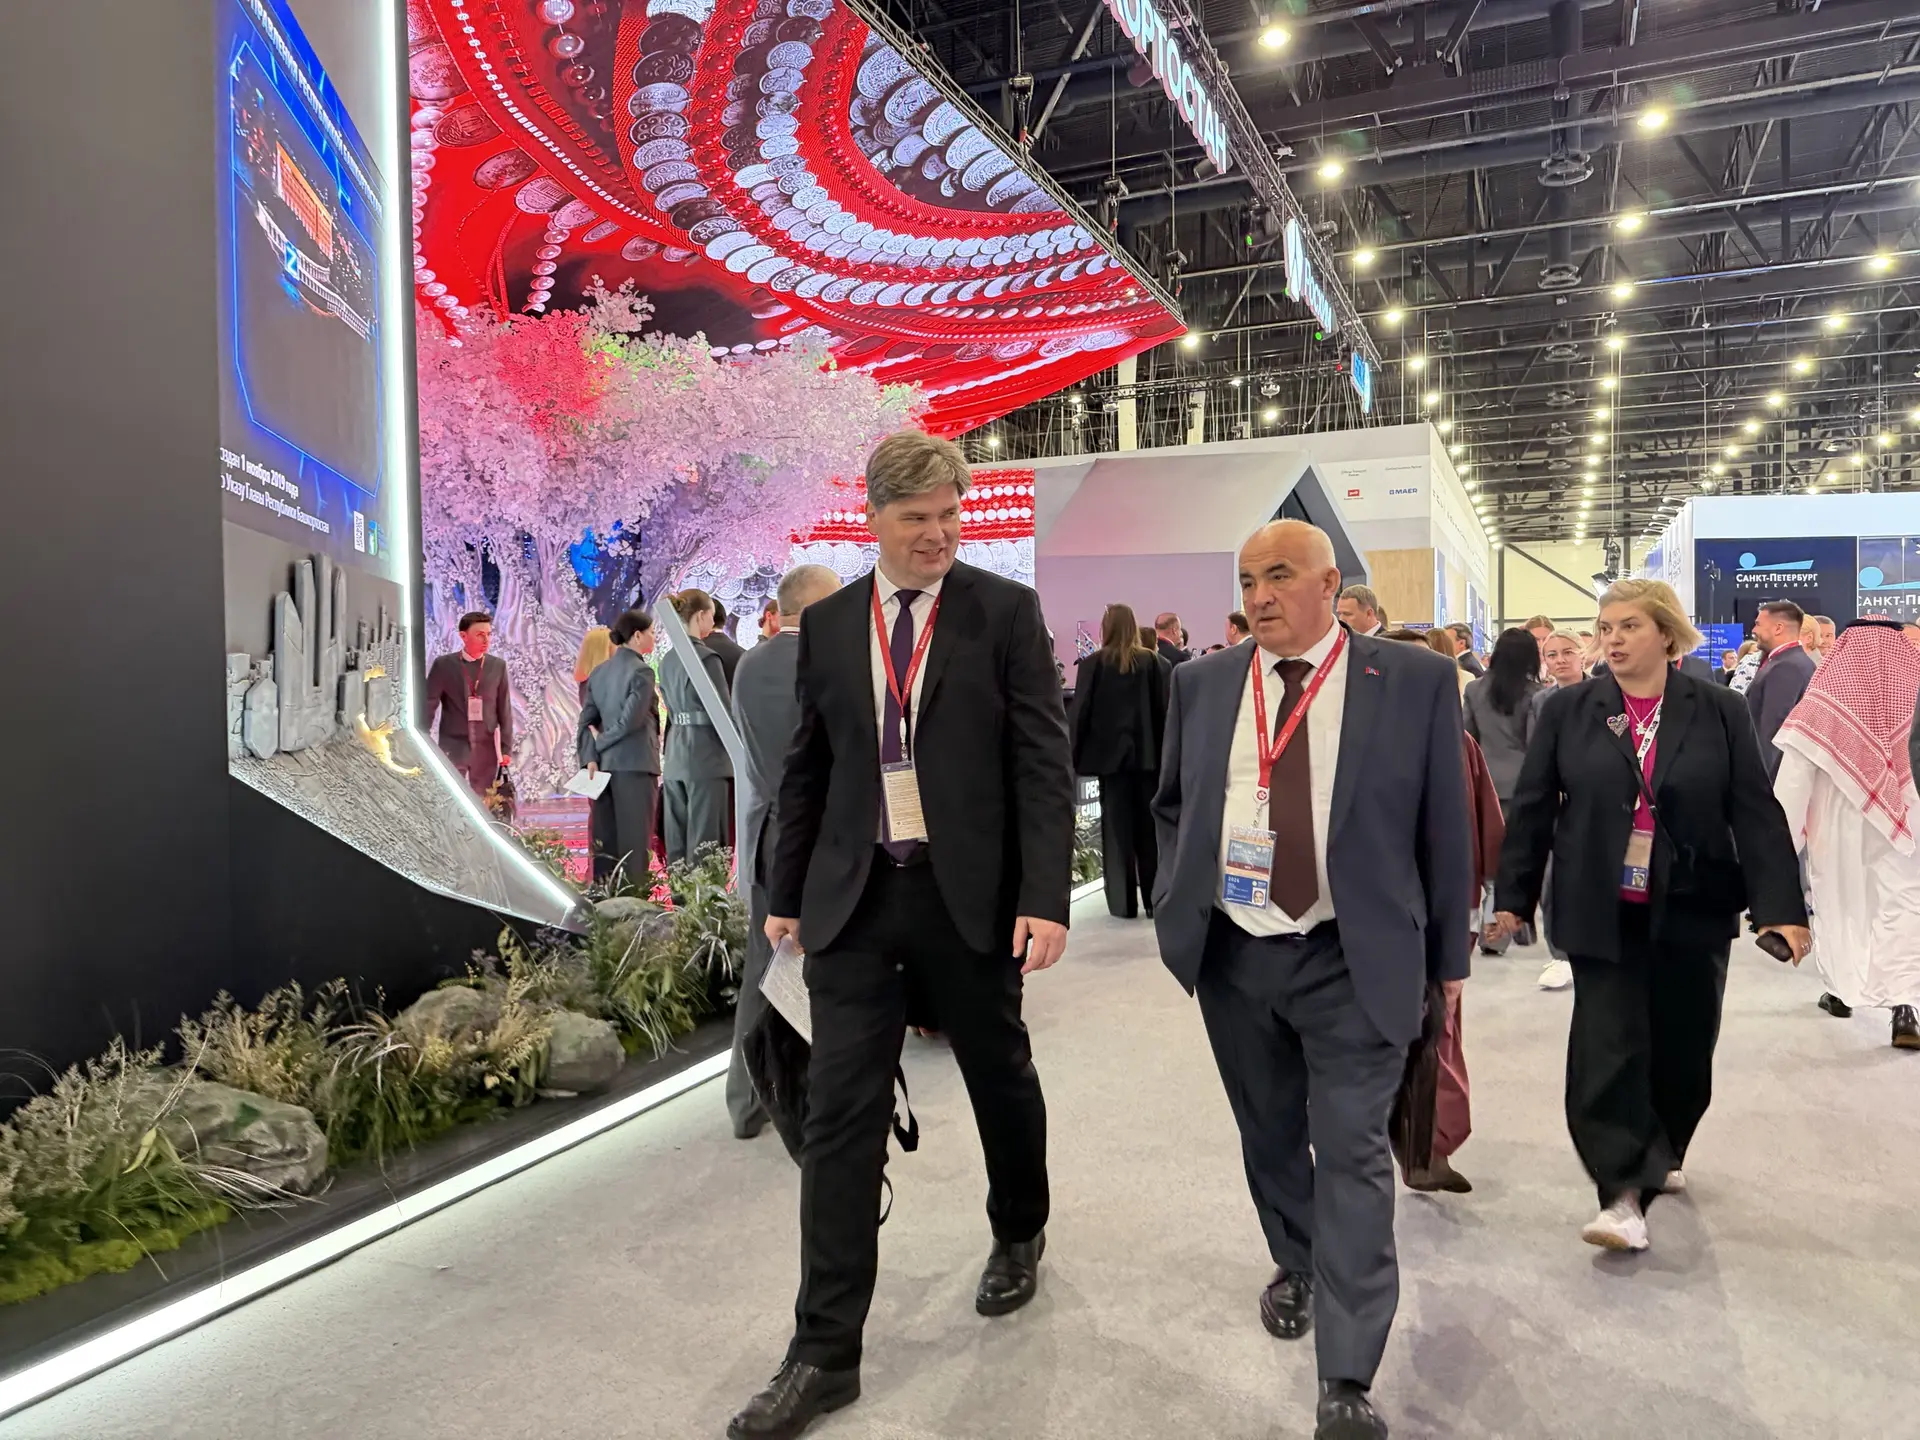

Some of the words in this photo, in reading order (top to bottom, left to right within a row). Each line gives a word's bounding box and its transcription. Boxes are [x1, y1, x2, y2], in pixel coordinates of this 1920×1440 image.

[248, 0, 298, 82] ПРАВЛЕНИЯ
[241, 454, 246, 471] 1
[270, 470, 286, 491] 2019
[285, 481, 299, 500] года
[1735, 573, 1818, 582] САНКТ-ПЕТЕРБУРГ
